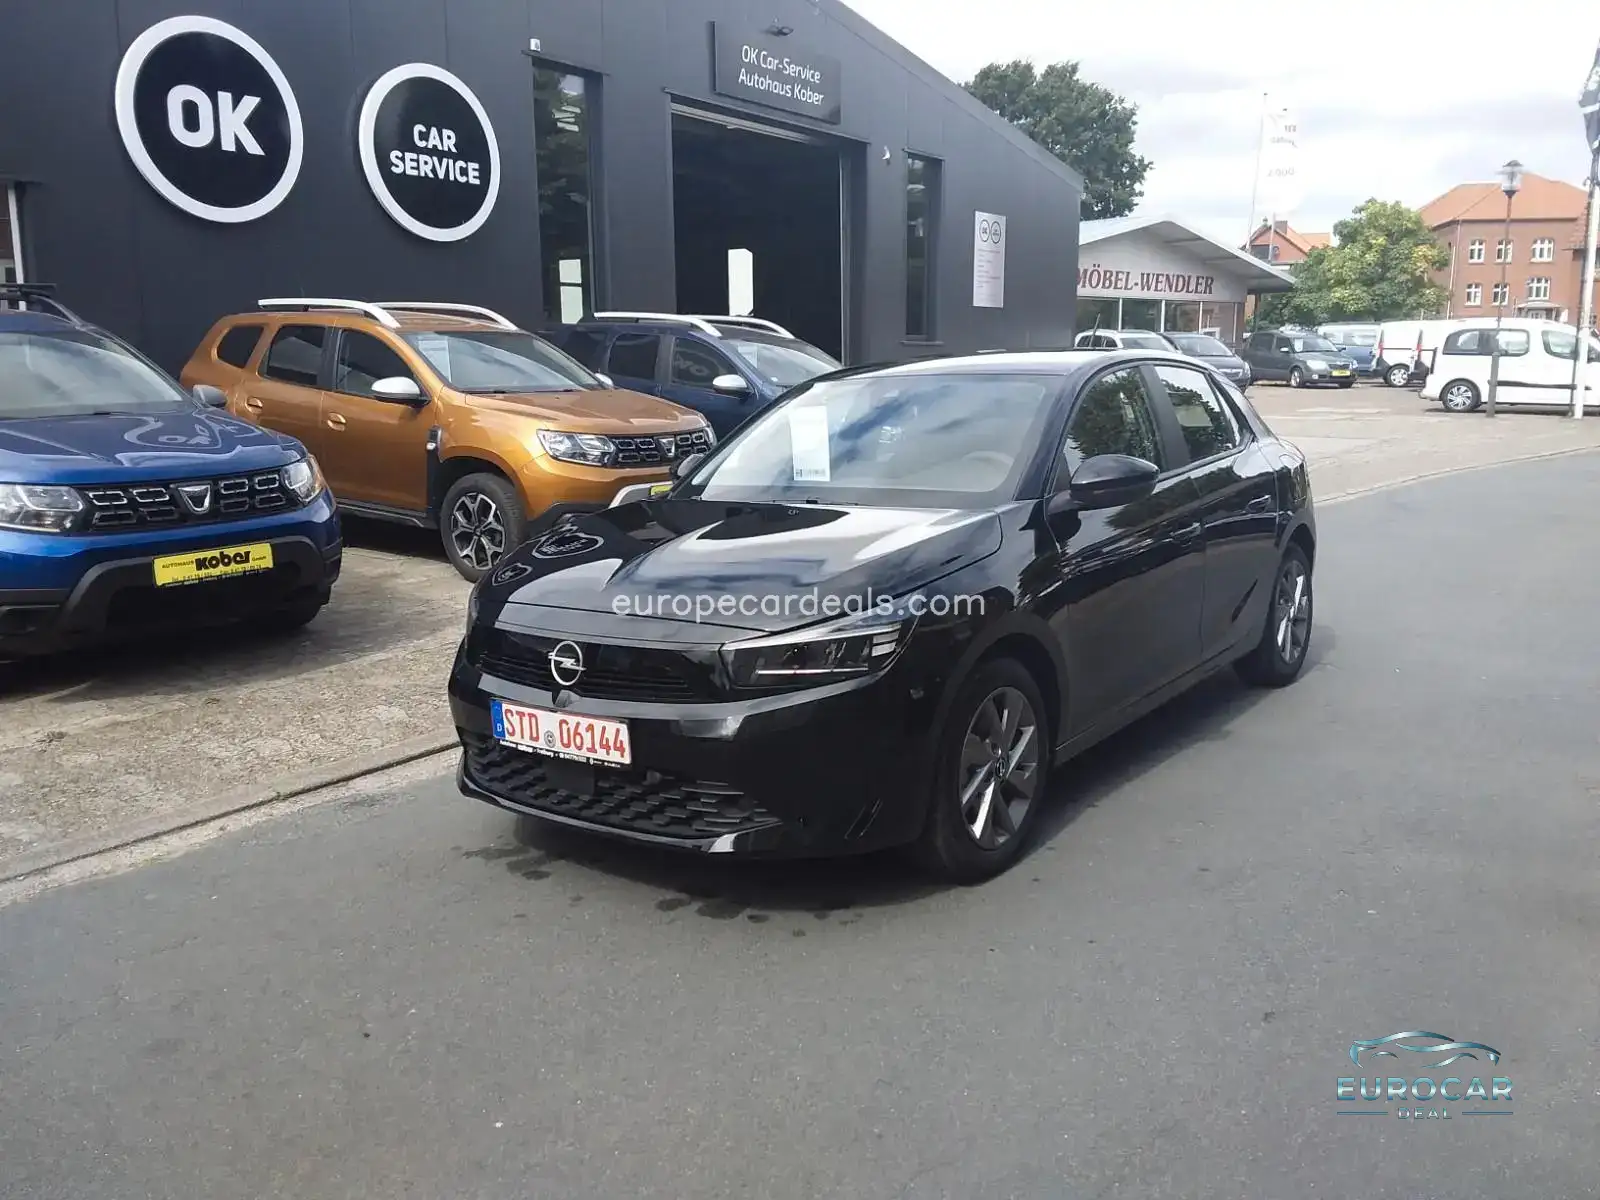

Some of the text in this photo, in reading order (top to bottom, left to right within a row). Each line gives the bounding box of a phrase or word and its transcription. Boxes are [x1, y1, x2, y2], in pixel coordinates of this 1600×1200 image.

[742, 45, 821, 84] OK Car-Service
[738, 68, 824, 105] Autohaus Kober
[167, 84, 265, 156] OK
[413, 124, 458, 153] CAR
[389, 150, 481, 185] SERVICE
[1076, 263, 1215, 295] MÖBEL-WENDLER
[496, 708, 626, 758] D STD 06144
